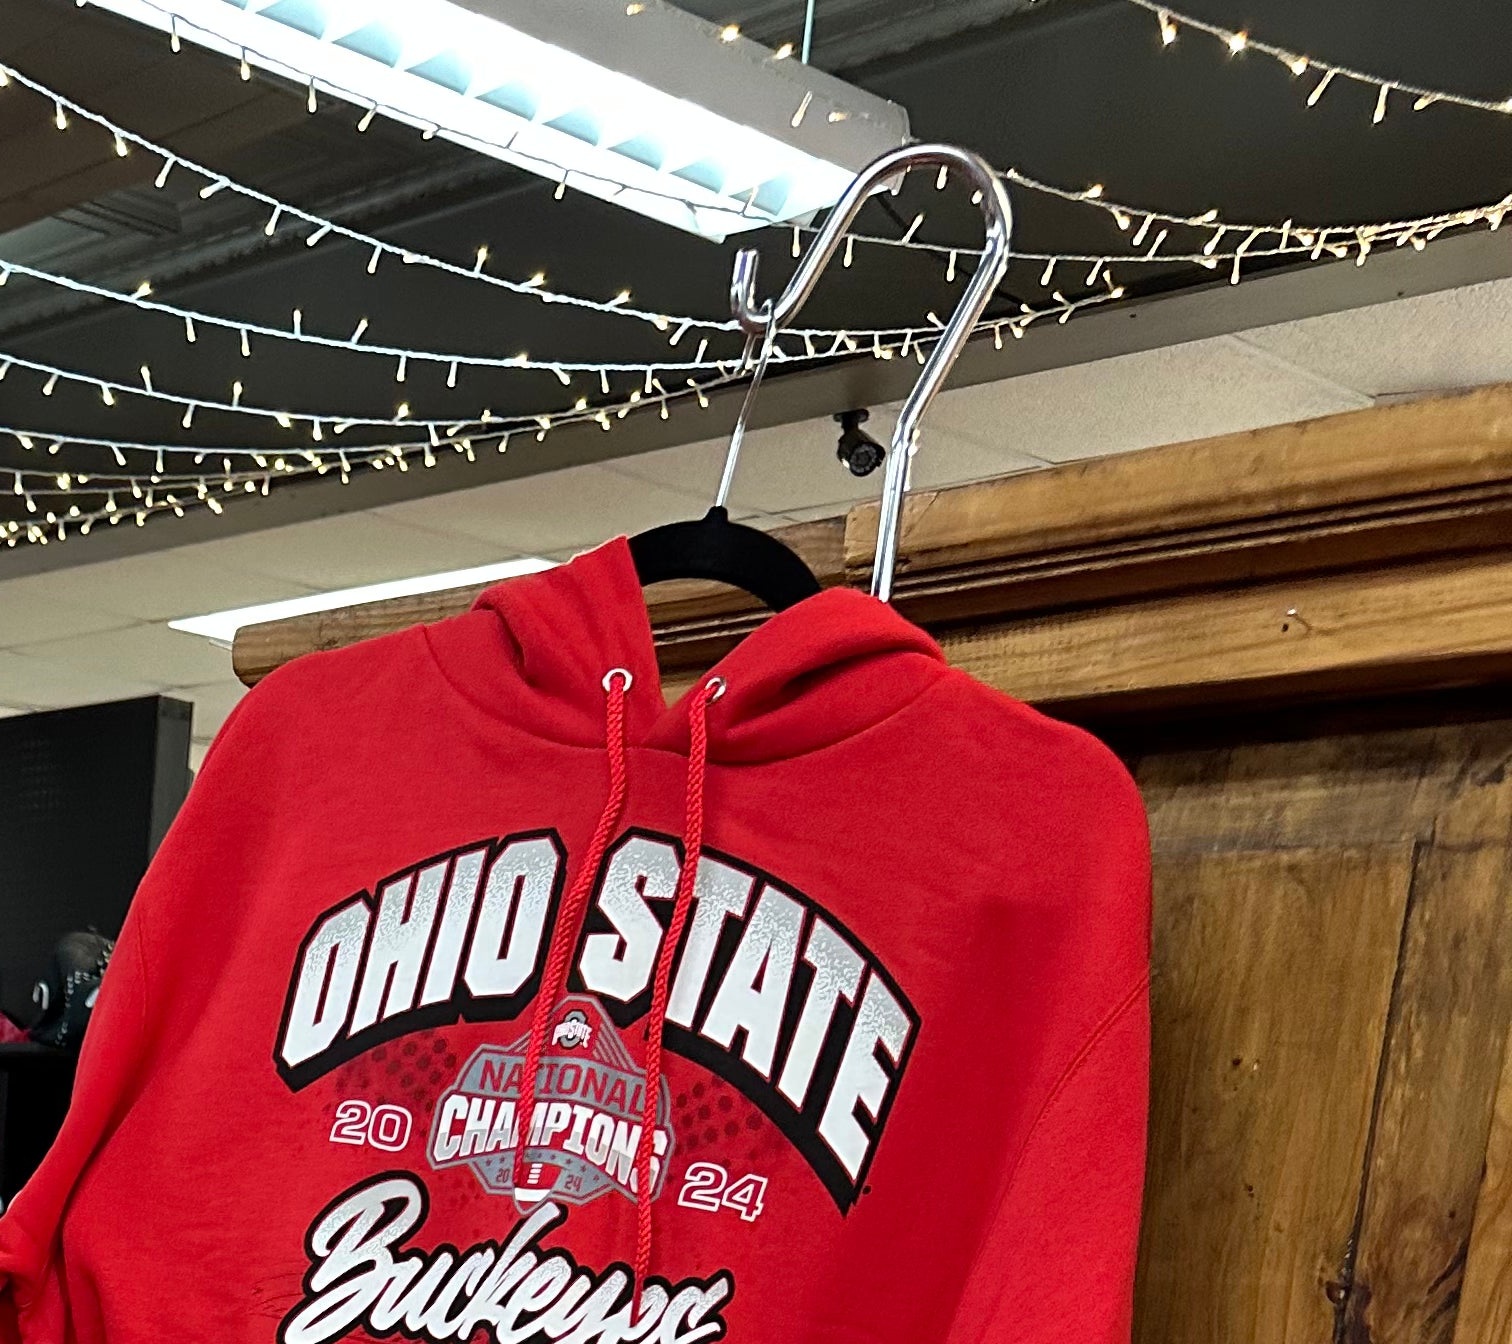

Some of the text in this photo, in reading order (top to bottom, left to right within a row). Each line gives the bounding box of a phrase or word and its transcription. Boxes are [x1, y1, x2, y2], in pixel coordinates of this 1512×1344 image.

[276, 828, 916, 1205] OHIO STATE
[476, 1058, 648, 1120] NAIONAL
[329, 1100, 765, 1222] 20 24
